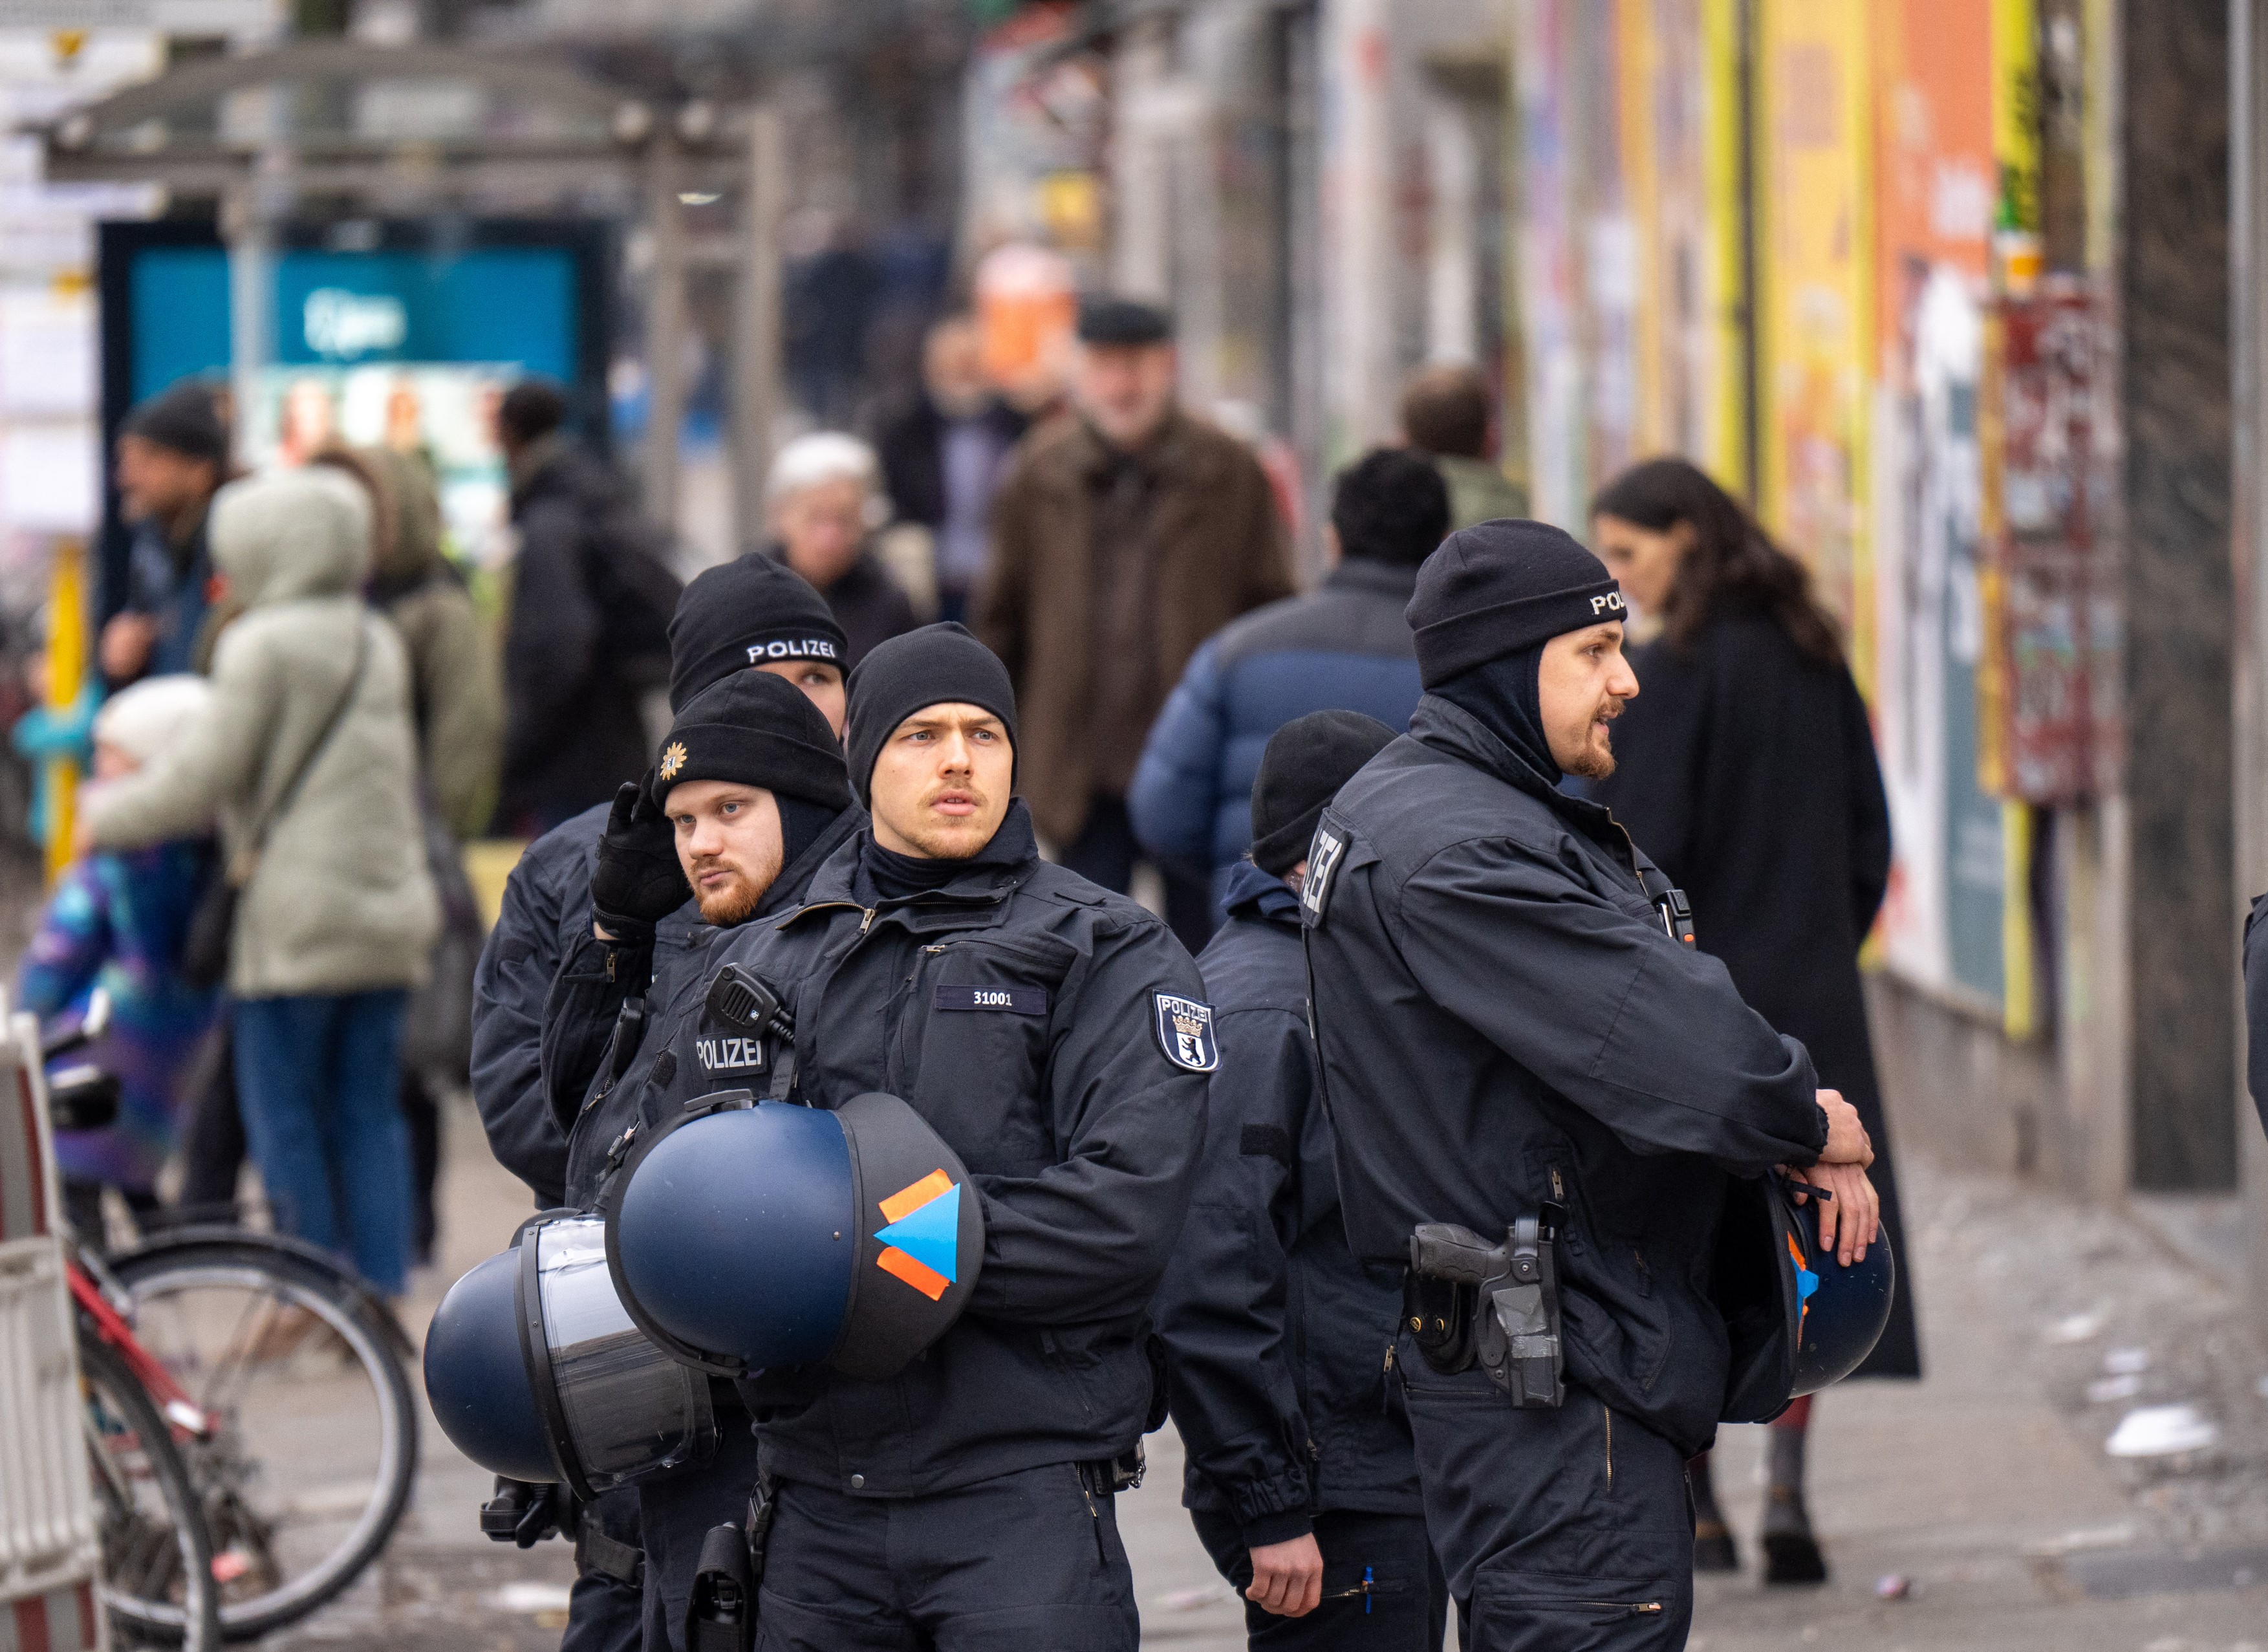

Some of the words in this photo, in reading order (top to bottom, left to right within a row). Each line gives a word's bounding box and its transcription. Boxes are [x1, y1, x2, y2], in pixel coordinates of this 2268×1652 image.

[746, 639, 836, 664] POLIZEI
[974, 991, 1013, 1006] 31001
[1161, 998, 1208, 1023] POLIZEI
[696, 1038, 762, 1071] POLIZEI
